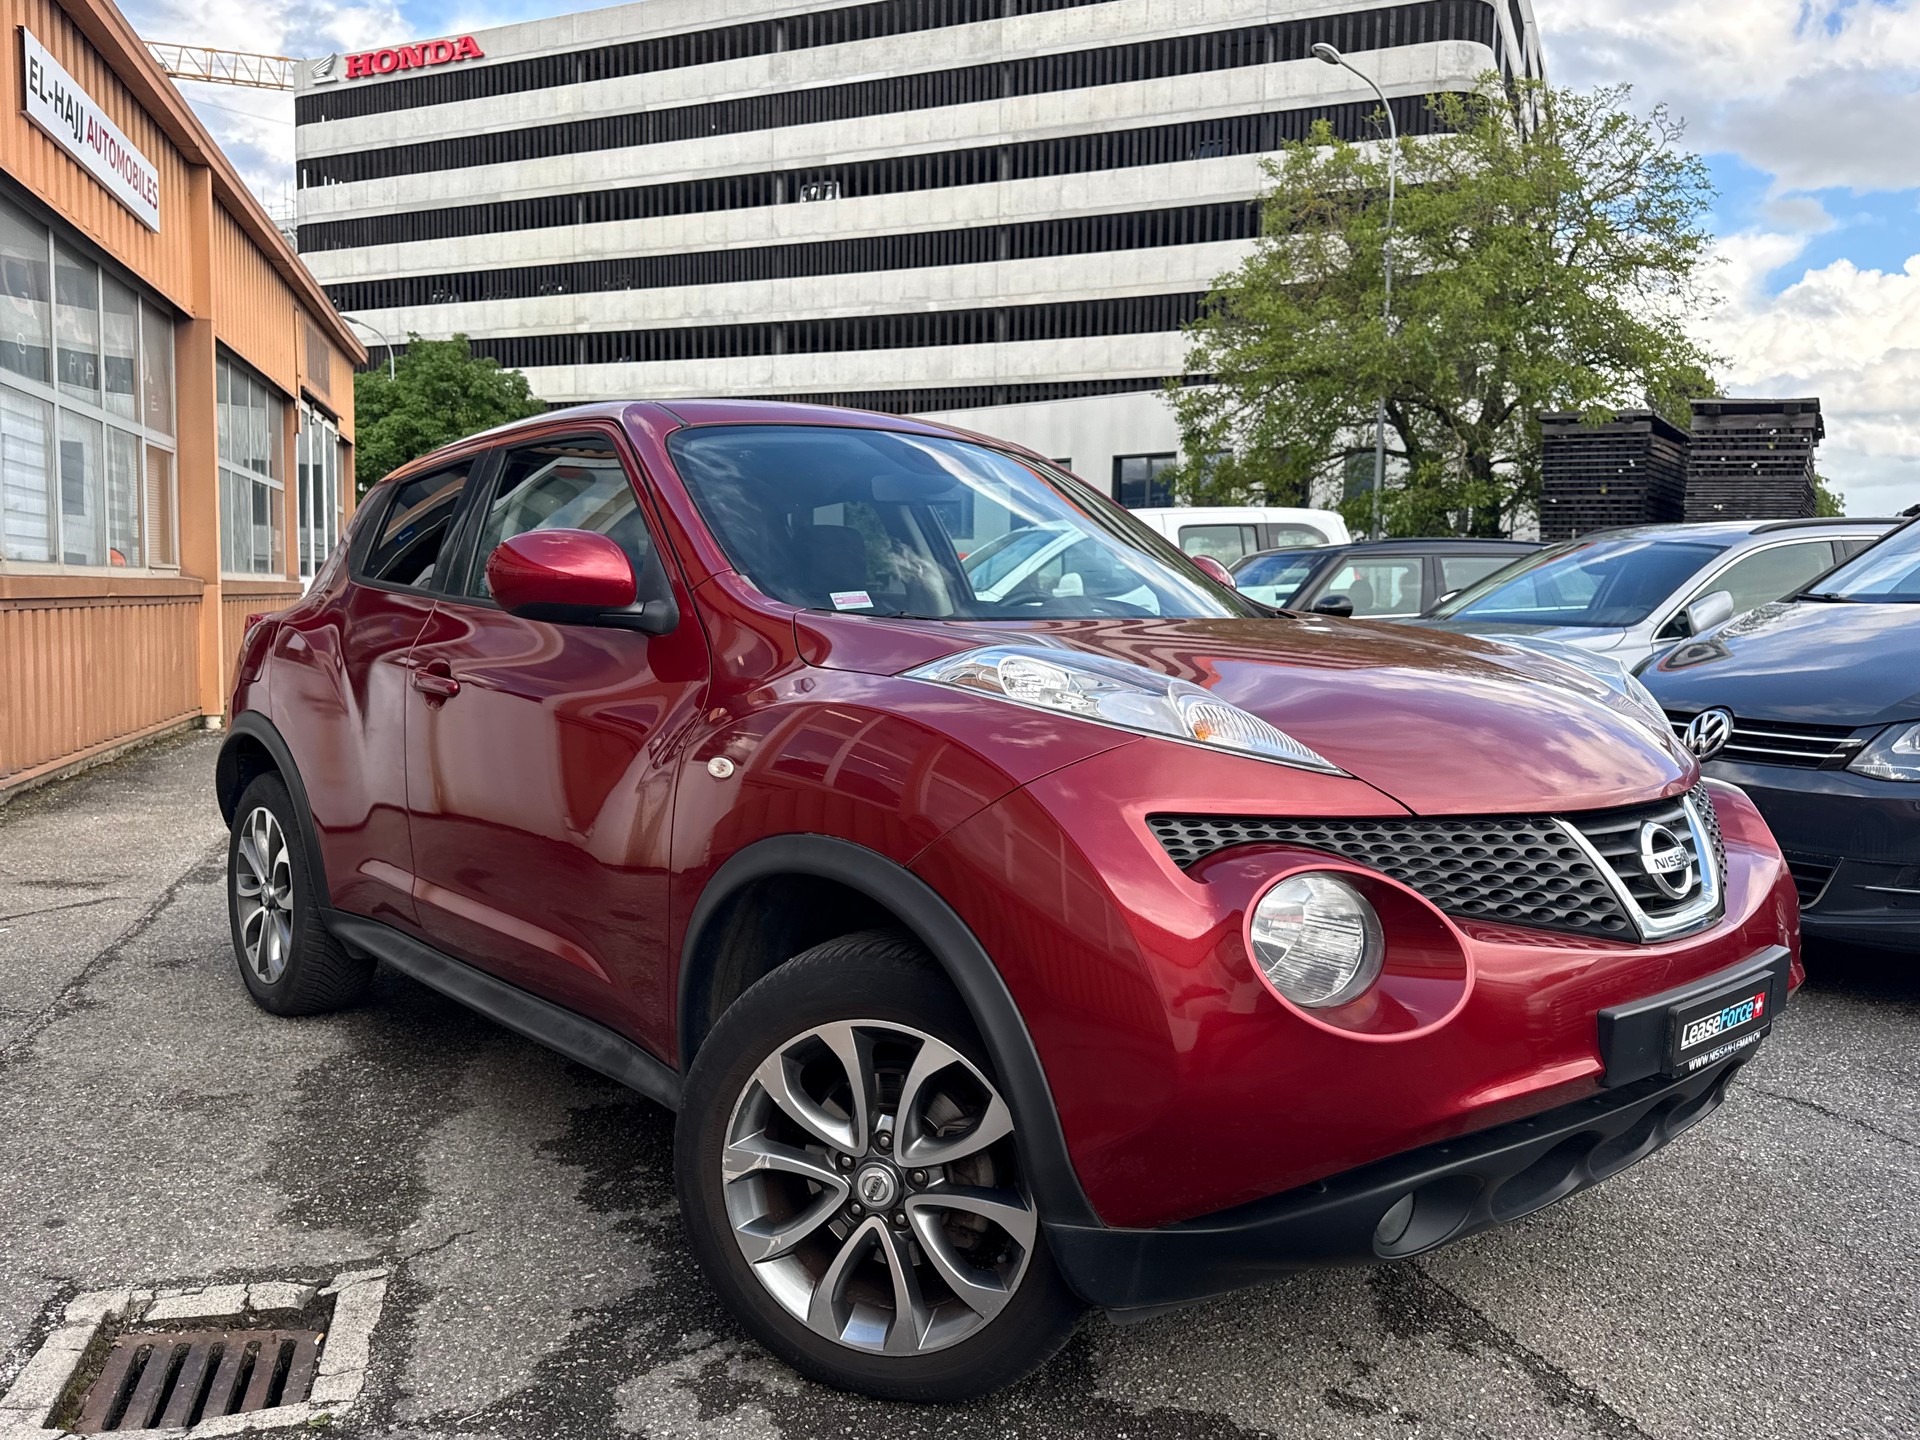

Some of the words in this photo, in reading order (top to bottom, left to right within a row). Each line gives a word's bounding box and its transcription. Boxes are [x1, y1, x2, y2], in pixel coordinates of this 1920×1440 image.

[345, 35, 485, 79] HONDA
[29, 55, 84, 144] EL-HAJJ
[86, 115, 158, 210] AUTOMOBILES
[1681, 1001, 1754, 1048] LeaseForce
